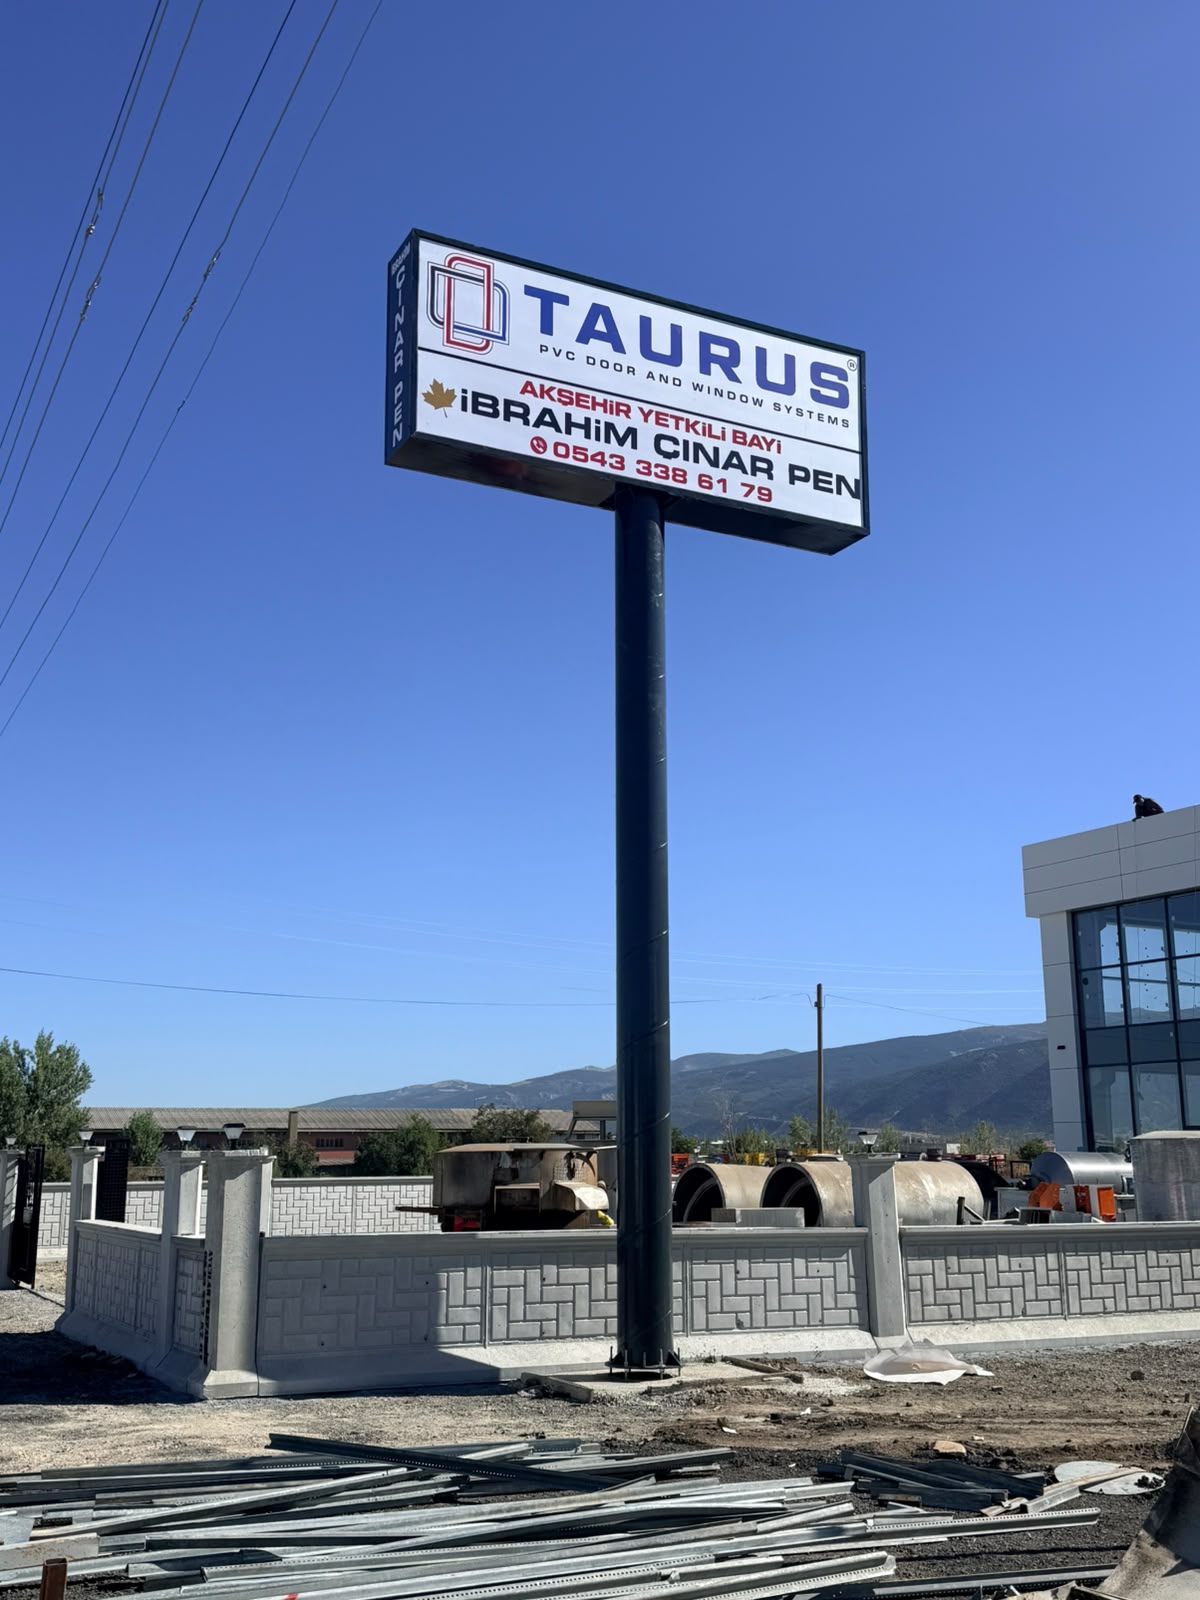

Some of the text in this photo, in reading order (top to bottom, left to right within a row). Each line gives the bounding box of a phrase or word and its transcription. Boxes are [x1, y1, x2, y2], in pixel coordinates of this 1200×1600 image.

[524, 284, 850, 409] TAURUS
[540, 344, 850, 428] PVC DOOR AND WINDOW SYSTEMS
[552, 441, 773, 503] 0543 338 61 79
[653, 433, 774, 481] ÇINAR
[788, 463, 861, 500] PEN
